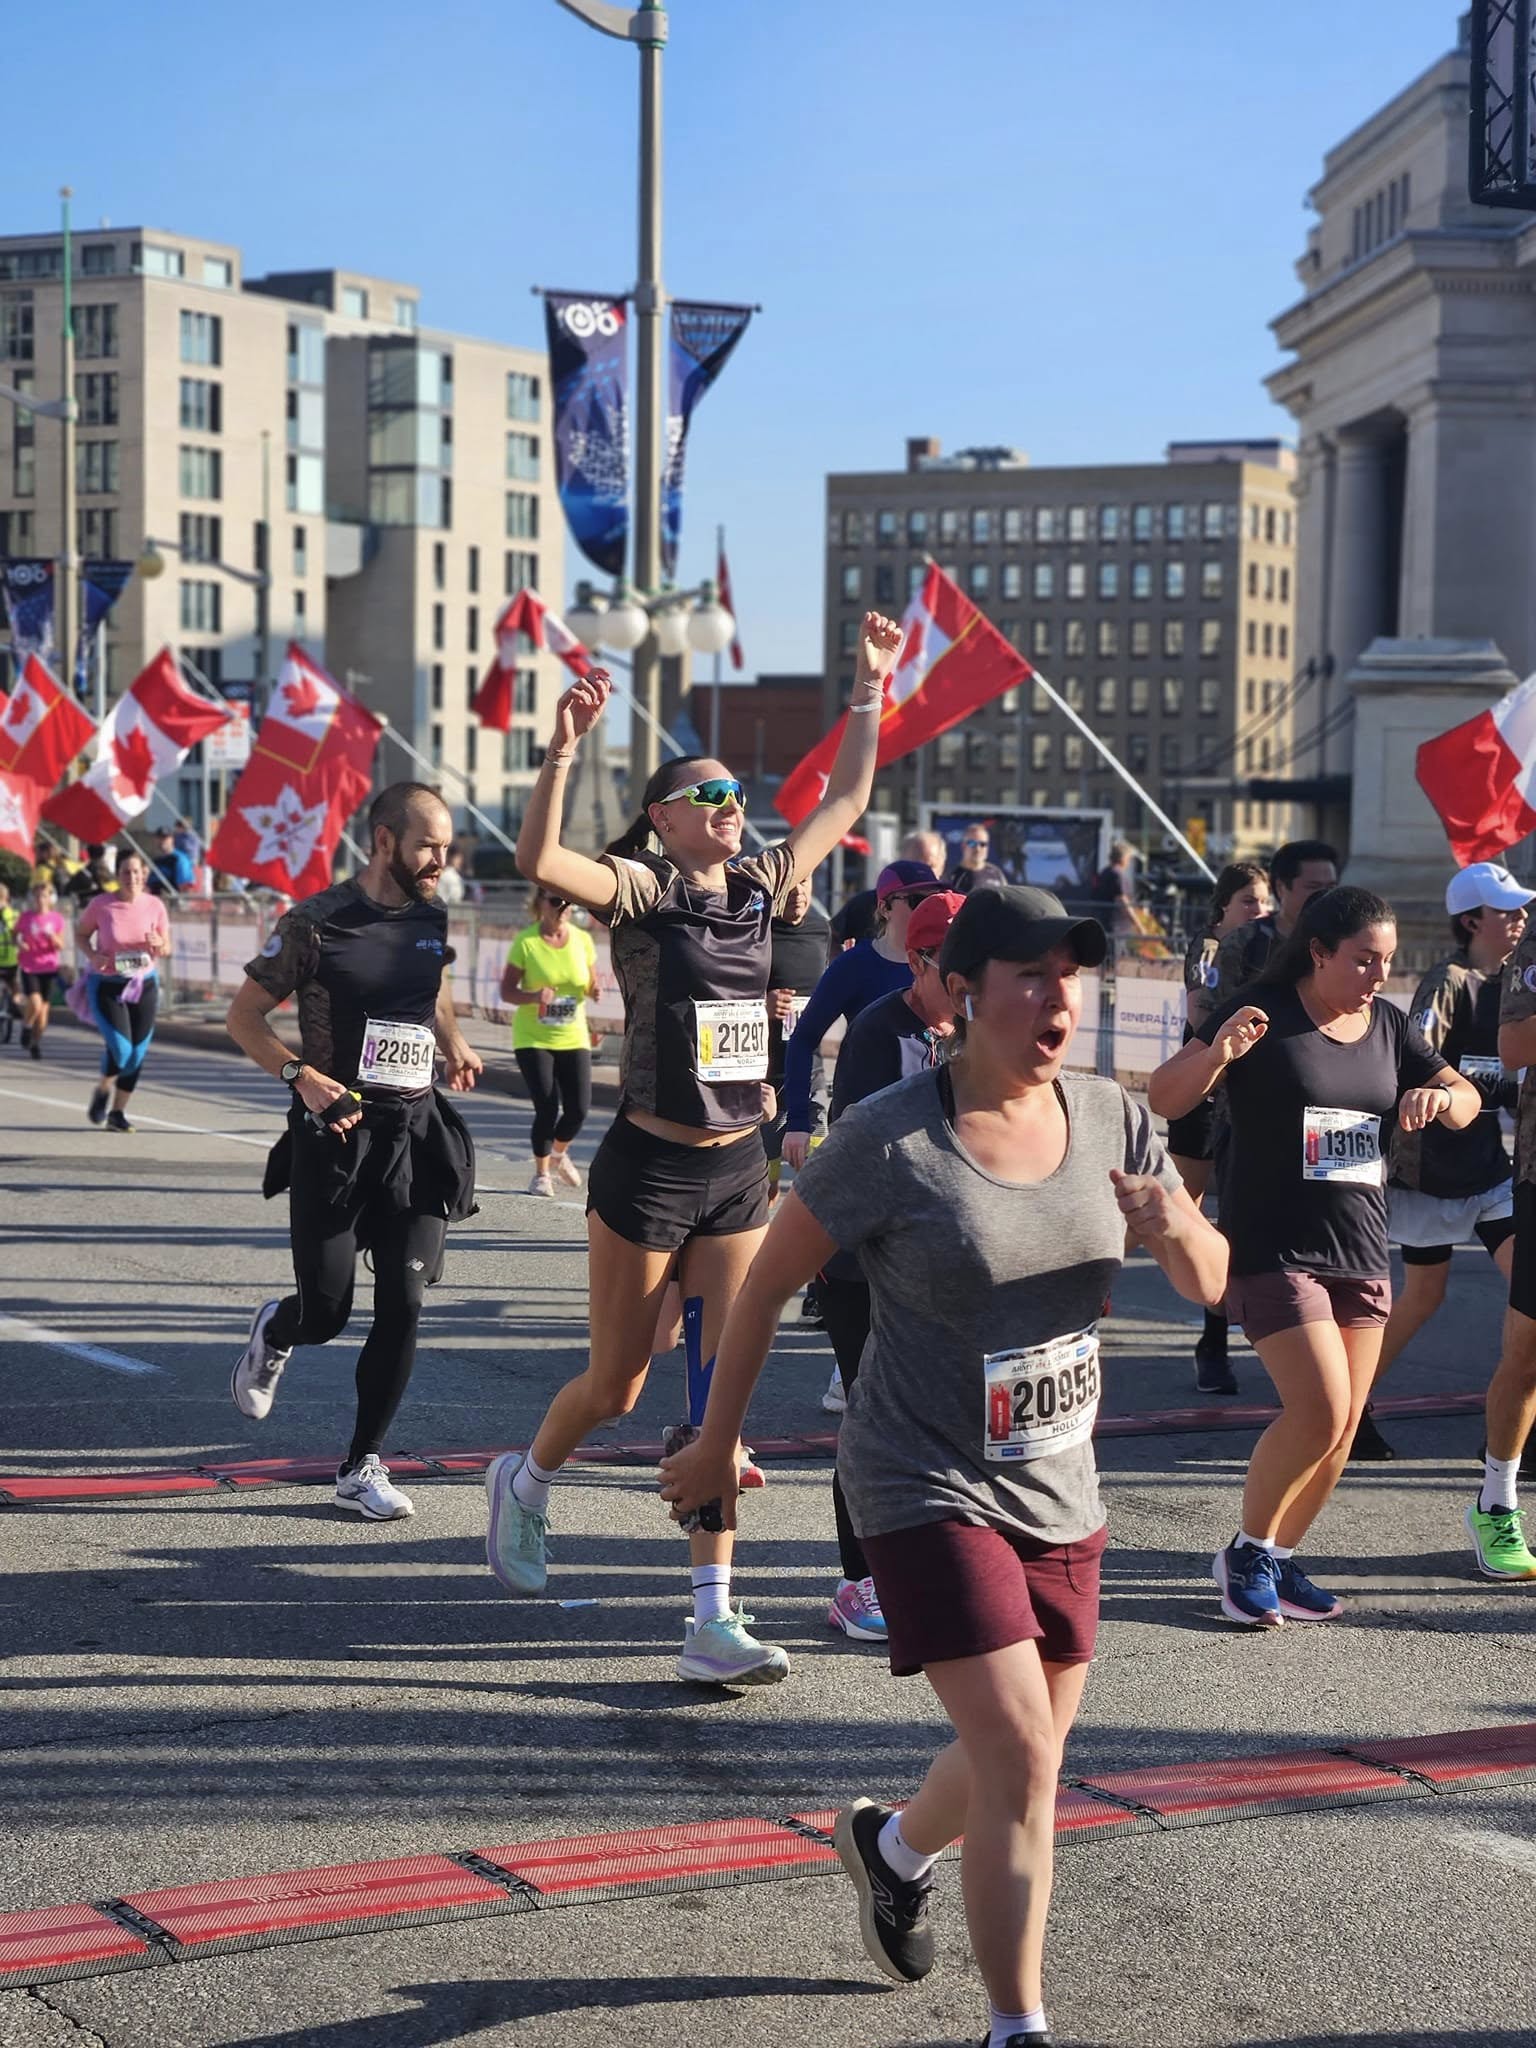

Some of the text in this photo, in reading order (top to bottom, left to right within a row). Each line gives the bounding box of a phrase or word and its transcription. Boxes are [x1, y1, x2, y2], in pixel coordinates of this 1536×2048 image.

[1120, 1012, 1168, 1025] GENERAL
[718, 1022, 764, 1053] 21297
[376, 1039, 430, 1068] 22854
[1325, 1129, 1375, 1160] 13163
[1013, 1354, 1097, 1424] 20955
[1052, 1417, 1080, 1434] HOLLY
